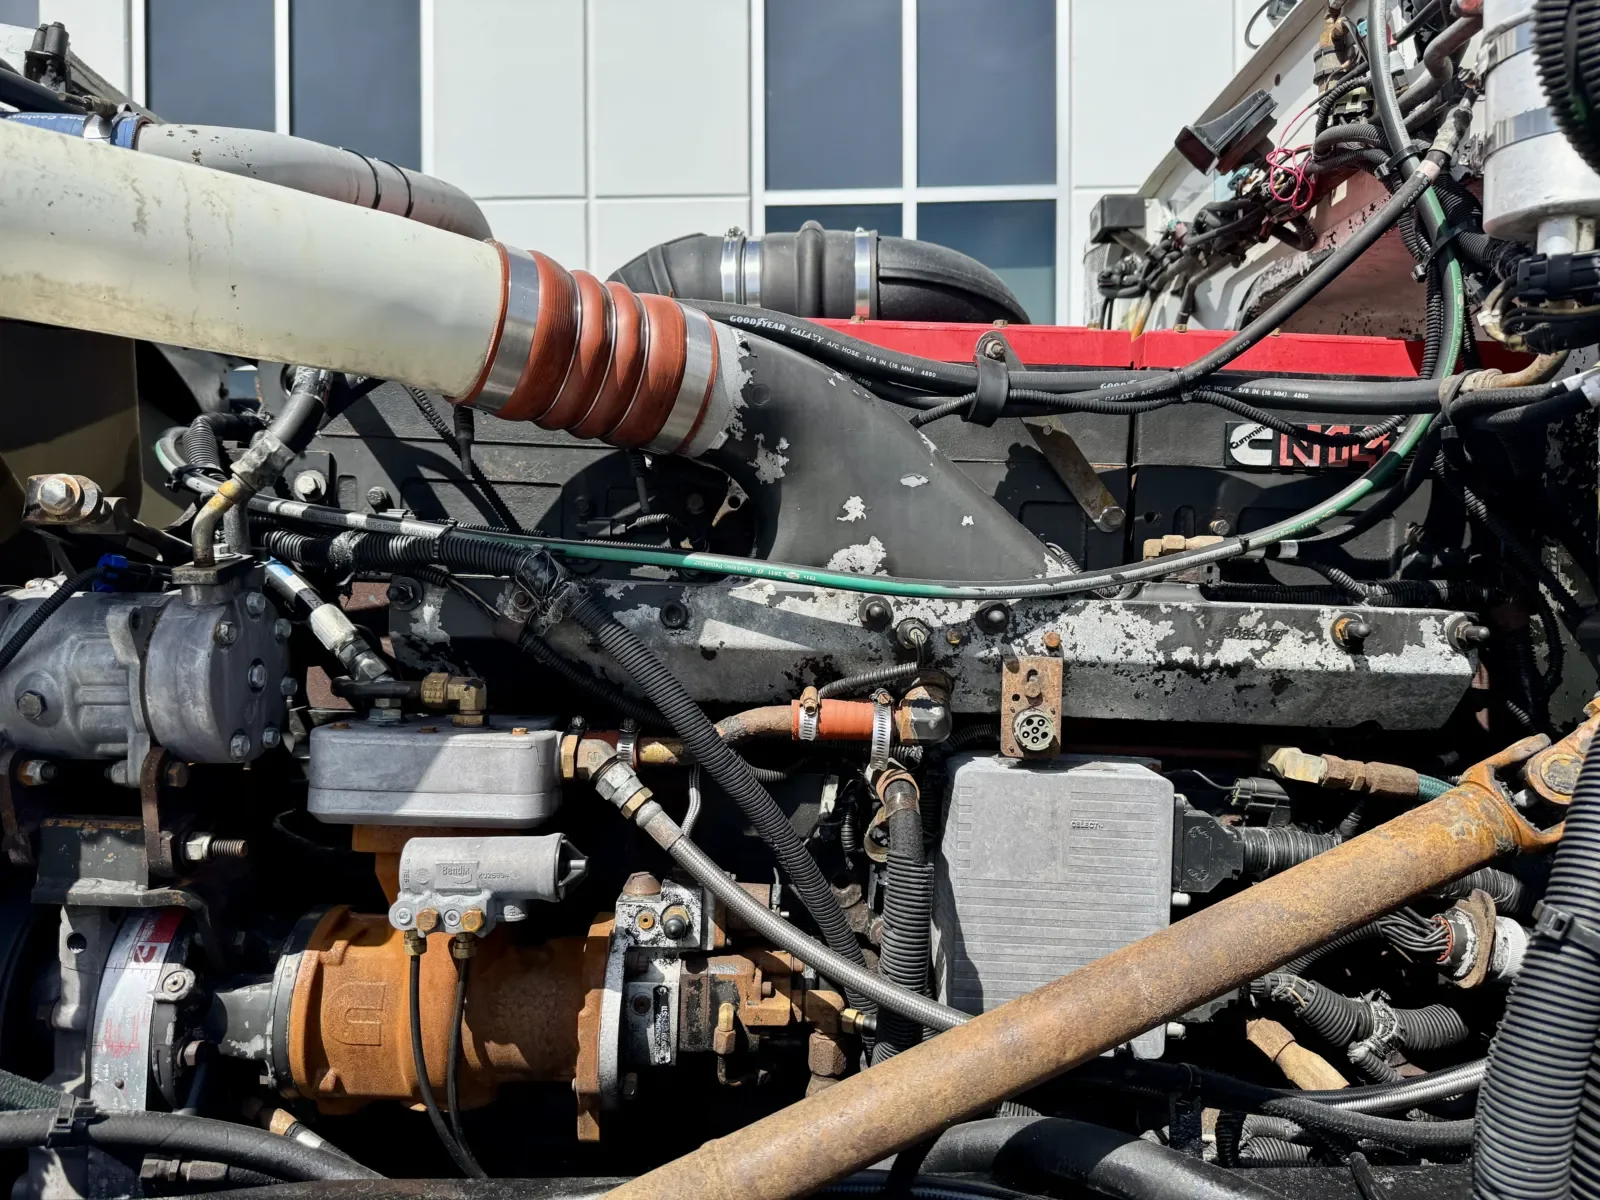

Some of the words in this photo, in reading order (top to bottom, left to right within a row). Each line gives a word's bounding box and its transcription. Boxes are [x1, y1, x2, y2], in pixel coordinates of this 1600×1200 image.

[730, 315, 787, 331] GOODYEAR
[790, 327, 825, 342] GALAXY
[827, 340, 840, 349] A/C
[841, 346, 860, 357] HOSE
[900, 365, 915, 373] MM)
[920, 369, 937, 378] 4860
[1230, 425, 1267, 449] Cummin
[442, 865, 471, 876] Bendix
